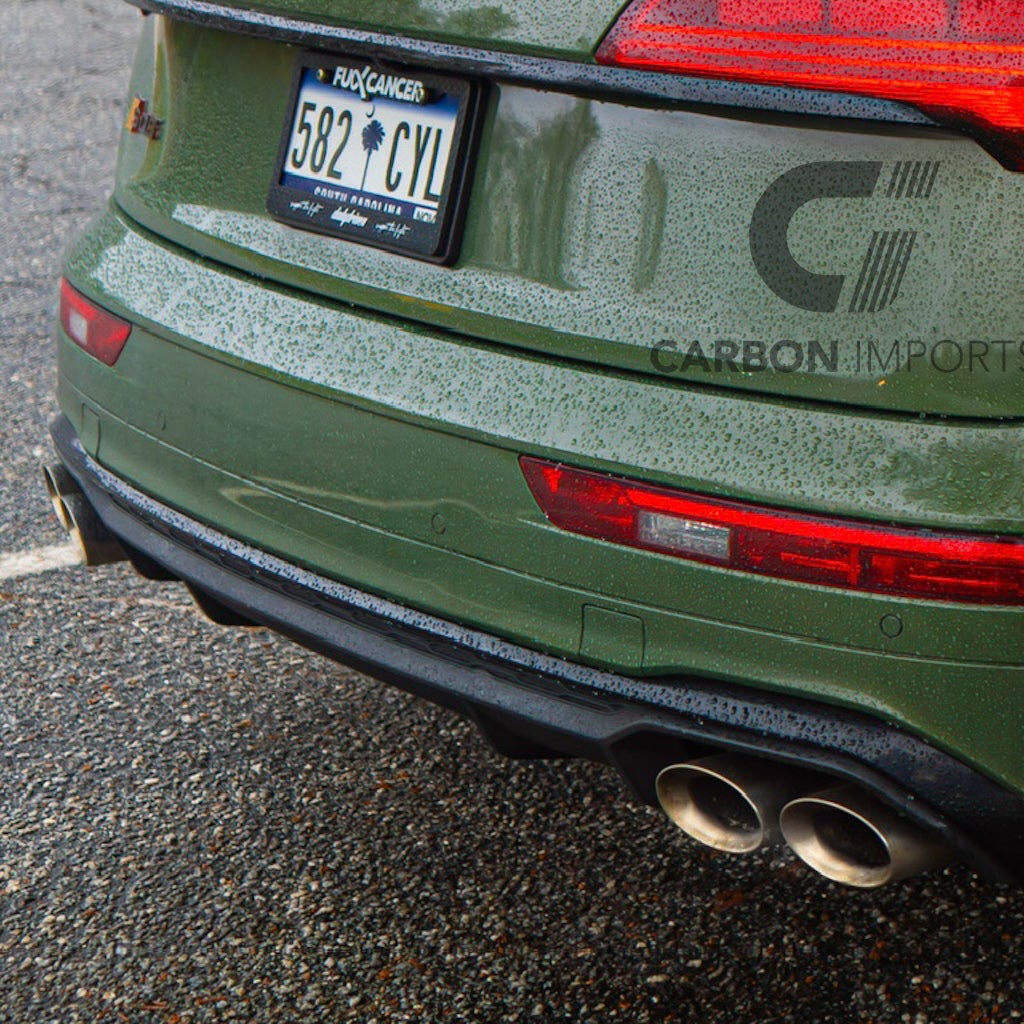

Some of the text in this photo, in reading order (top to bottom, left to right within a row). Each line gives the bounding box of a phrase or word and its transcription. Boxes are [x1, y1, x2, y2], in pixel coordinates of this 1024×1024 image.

[365, 72, 424, 103] CANCER
[291, 102, 443, 202] 582 CYL
